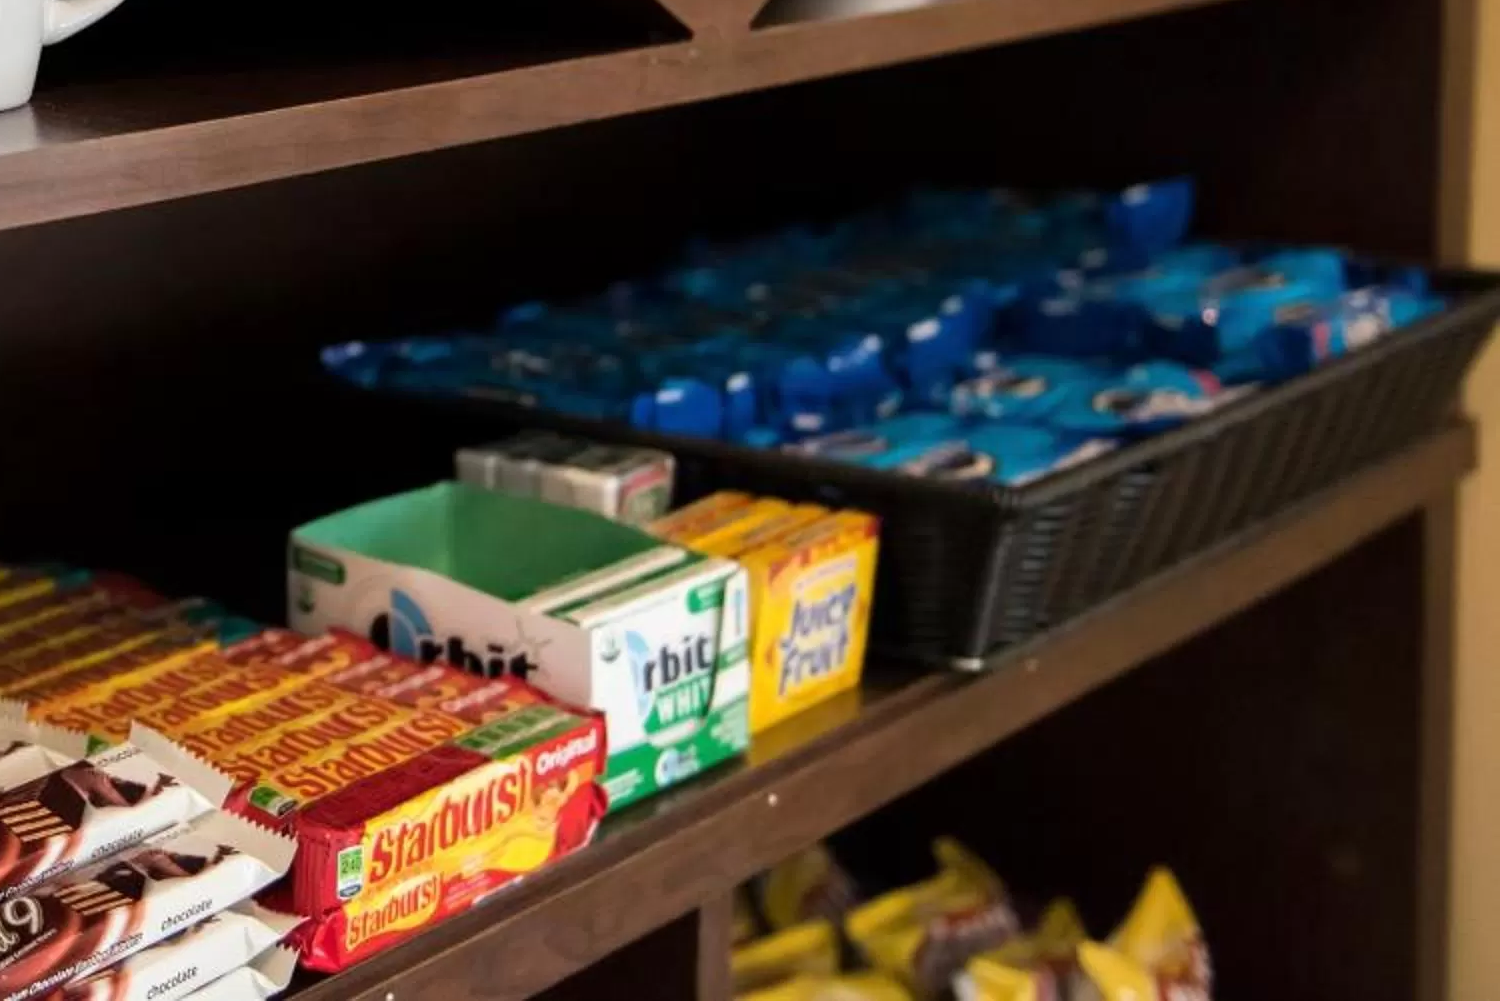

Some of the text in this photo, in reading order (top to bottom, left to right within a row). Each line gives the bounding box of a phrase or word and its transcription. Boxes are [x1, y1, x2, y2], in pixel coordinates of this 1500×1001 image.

[220, 694, 402, 785] Starburst
[274, 707, 463, 799] Starburst
[534, 728, 598, 776] Original
[367, 763, 531, 886] Starburst
[3, 895, 46, 937] 9
[160, 898, 214, 932] chocolate
[348, 874, 440, 946] Starburst
[146, 964, 199, 1001] chocolate
